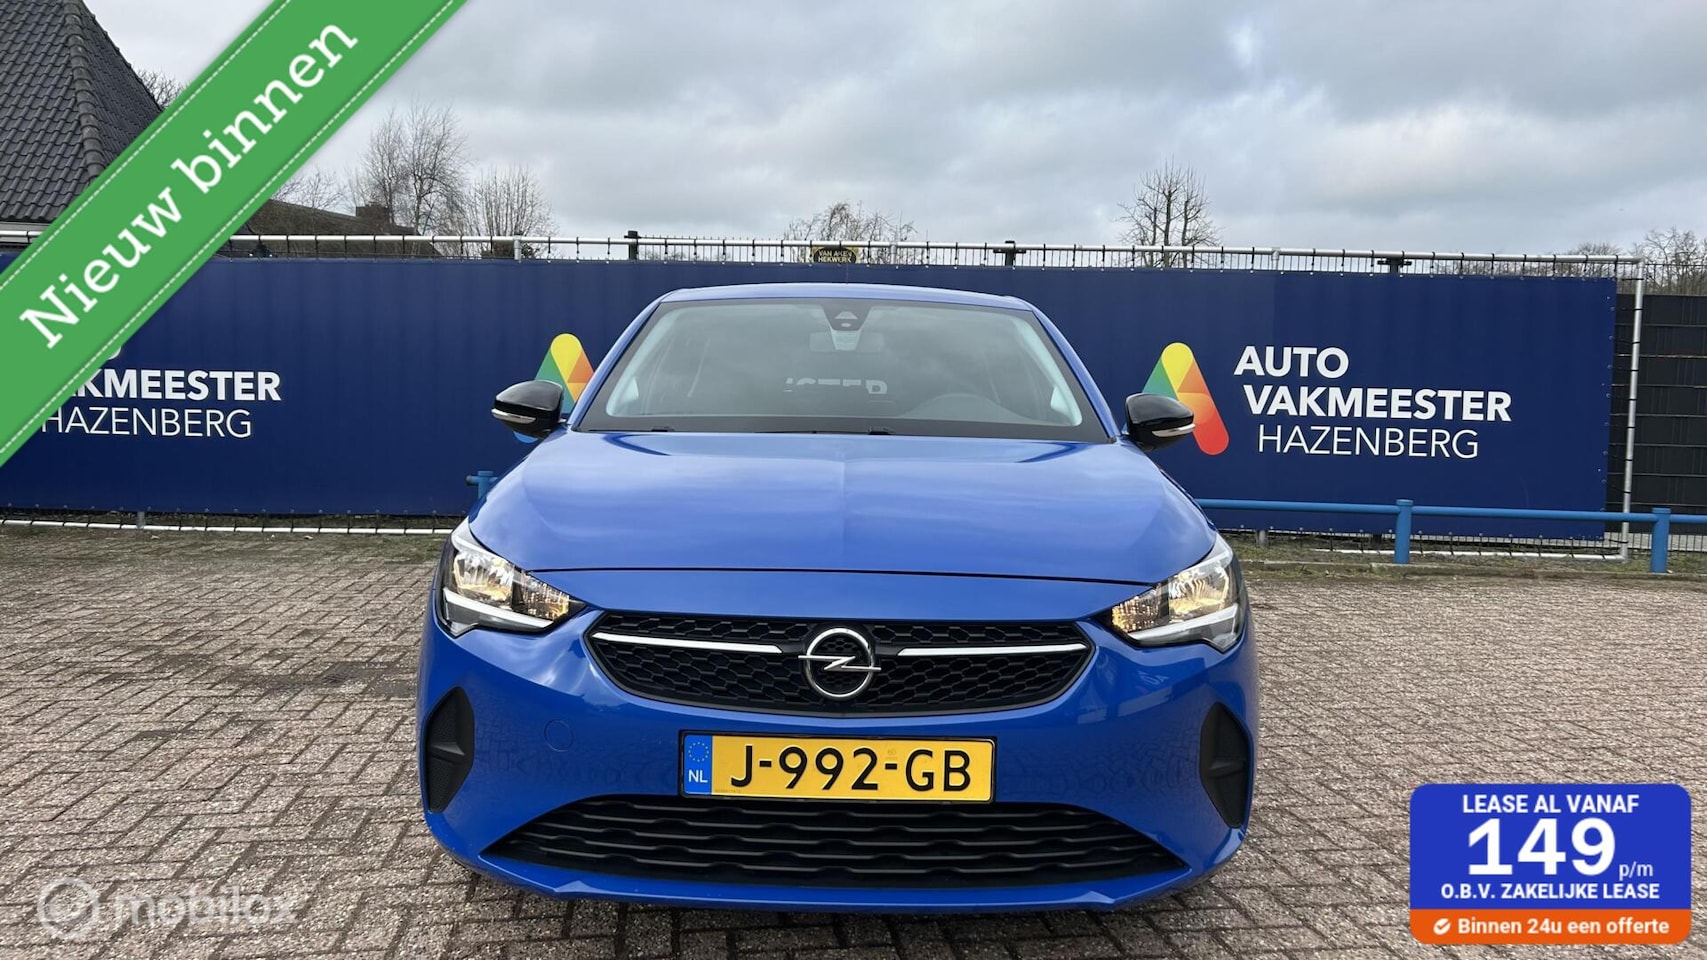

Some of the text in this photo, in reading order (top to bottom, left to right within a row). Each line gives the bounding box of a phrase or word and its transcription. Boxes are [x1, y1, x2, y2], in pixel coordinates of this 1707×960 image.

[1233, 345, 1350, 379] AUTO
[71, 369, 282, 401] KMEESTER
[1243, 384, 1512, 422] VAKMEESTER
[1258, 423, 1479, 459] HAZENBERG
[688, 769, 708, 783] NL
[730, 745, 972, 792] J-992-GB
